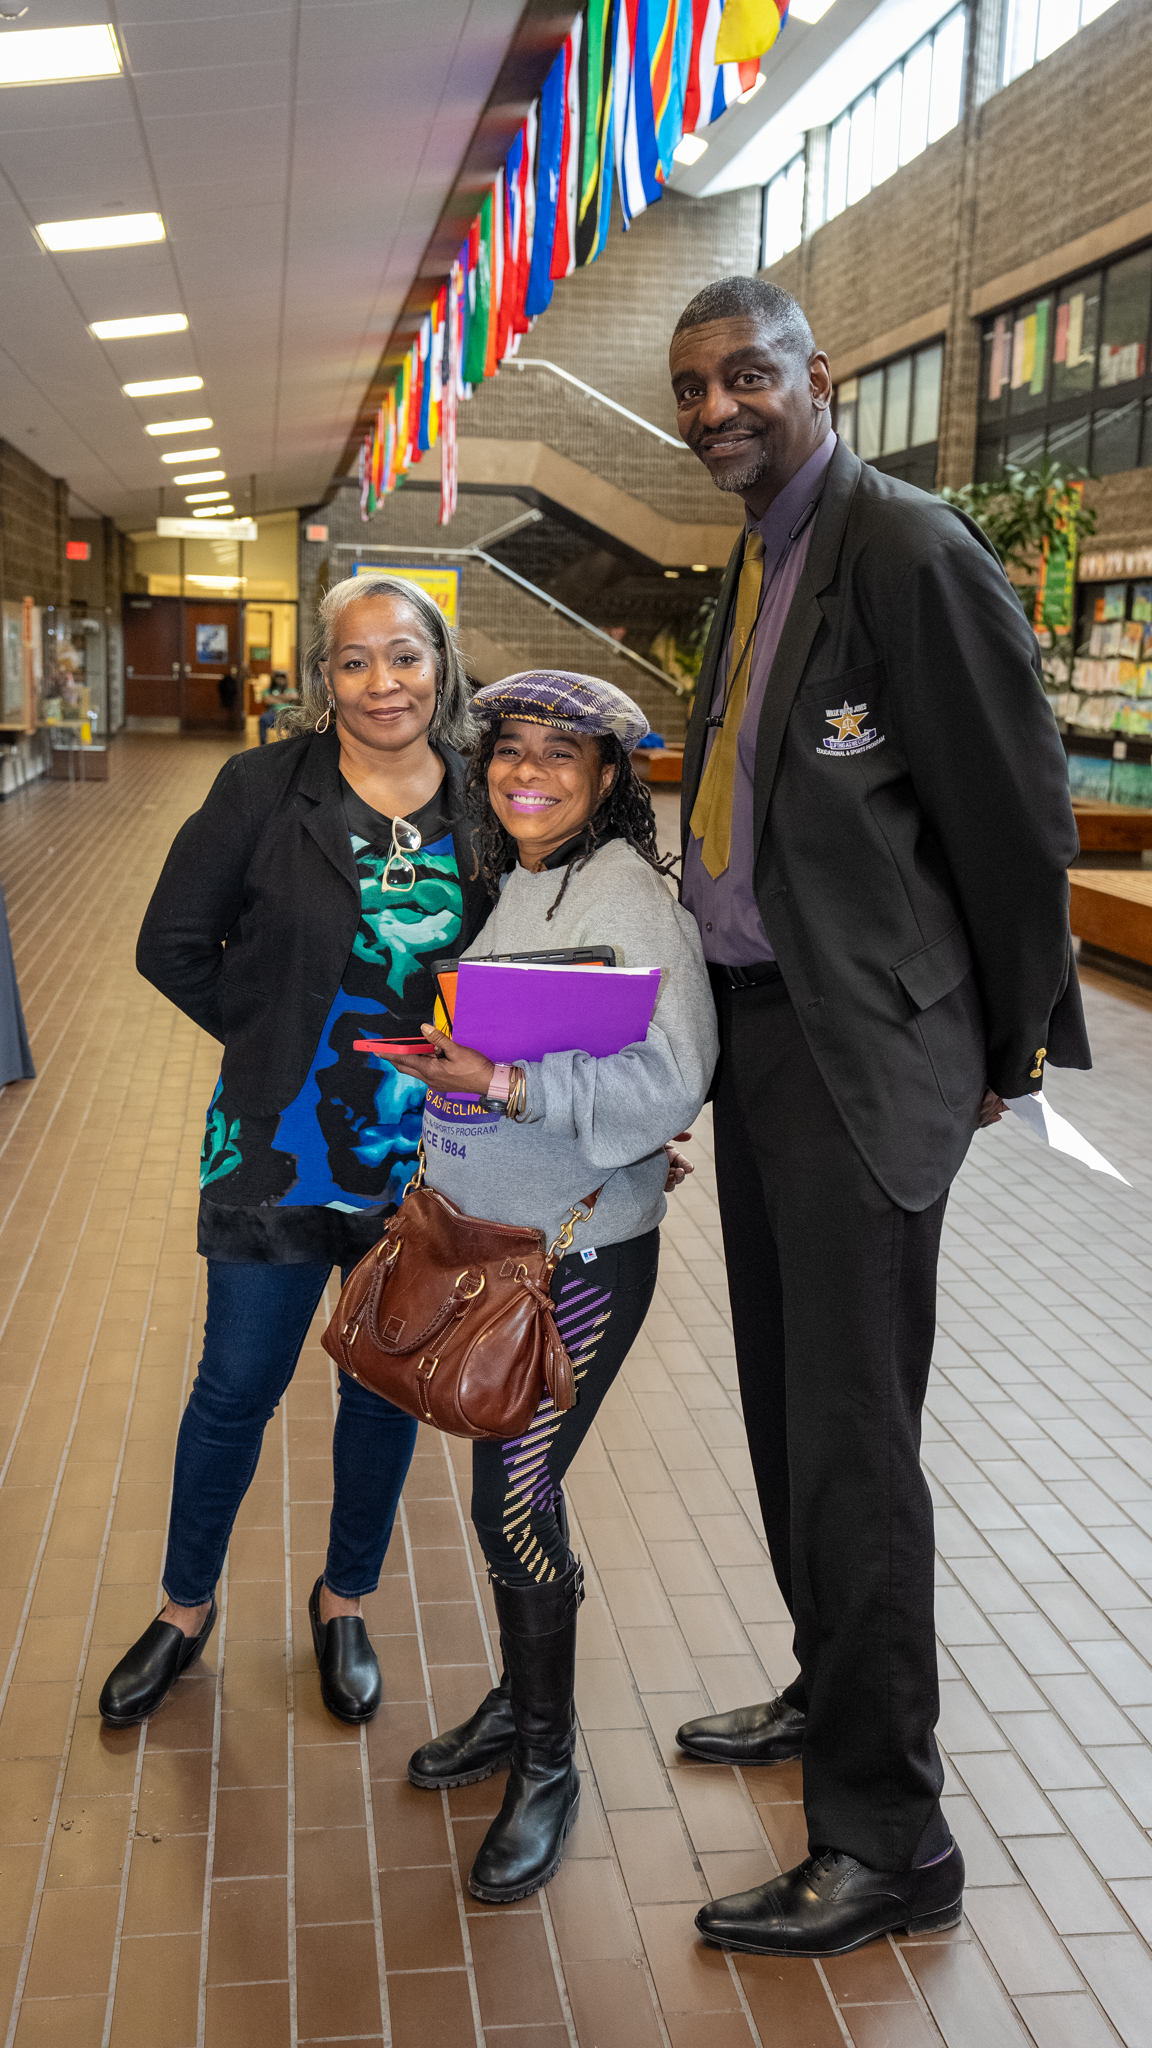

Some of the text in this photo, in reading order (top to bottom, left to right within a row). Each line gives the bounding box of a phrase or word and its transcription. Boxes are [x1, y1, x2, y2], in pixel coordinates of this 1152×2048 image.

[816, 747, 845, 756] EDUCATIONAL
[850, 747, 866, 756] SPORTS
[866, 735, 885, 751] PROGRAM
[431, 1095, 443, 1108] AS
[442, 1100, 452, 1114] WE
[453, 1103, 488, 1116] CLIM
[433, 1121, 454, 1135] SPORTS
[456, 1125, 498, 1136] PROGRAM
[441, 1137, 466, 1160] 1984
